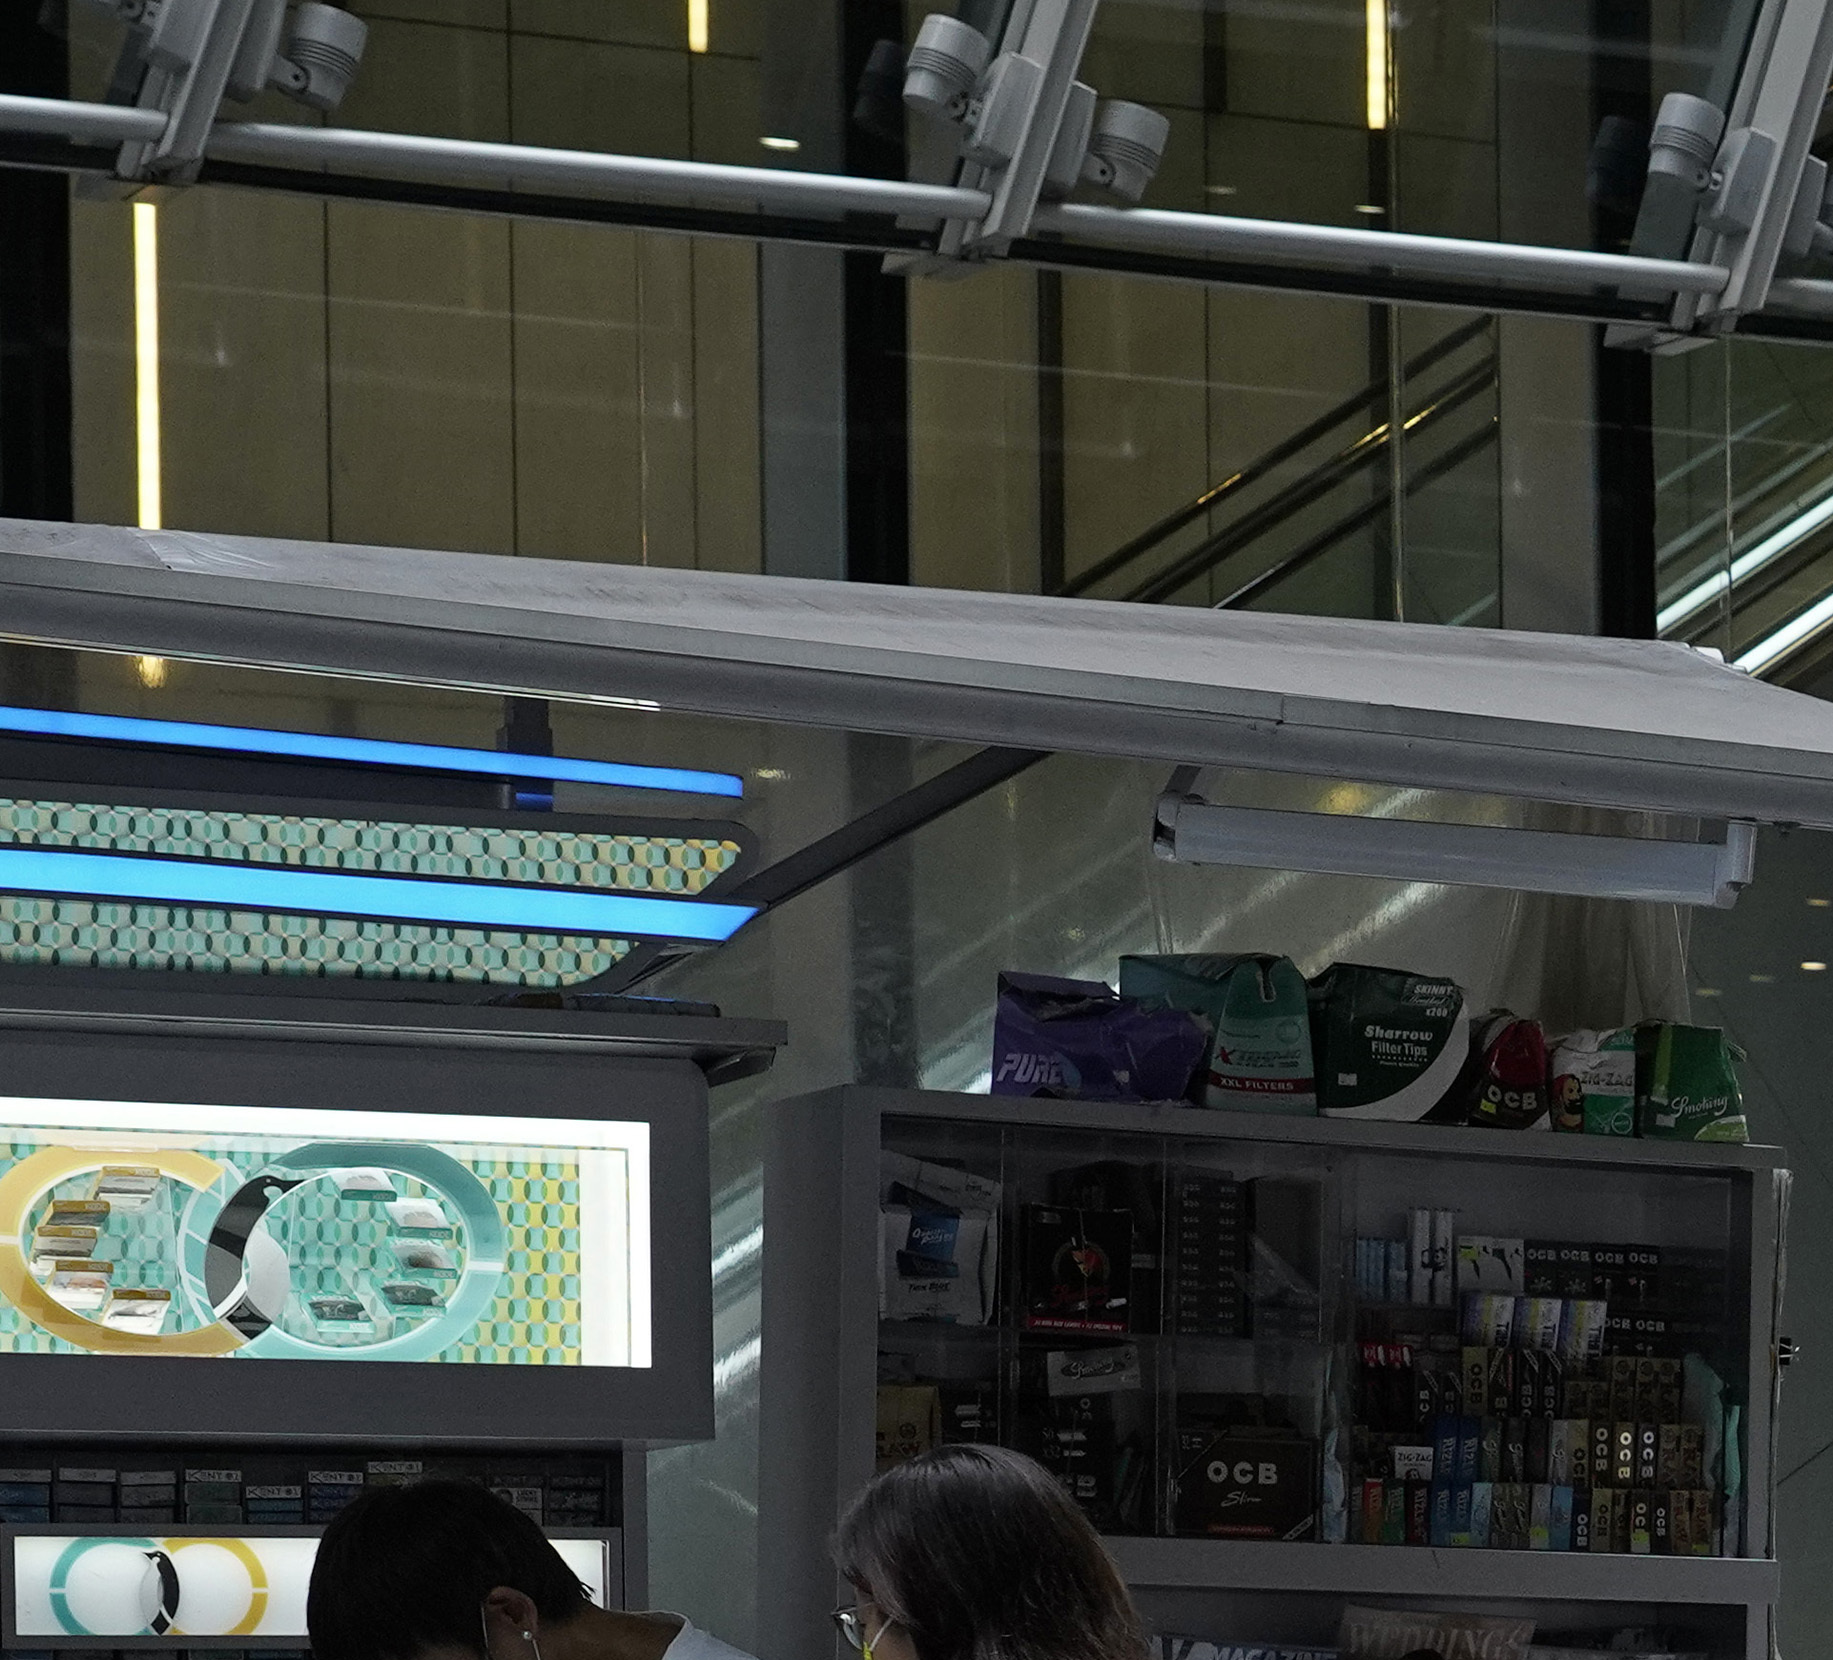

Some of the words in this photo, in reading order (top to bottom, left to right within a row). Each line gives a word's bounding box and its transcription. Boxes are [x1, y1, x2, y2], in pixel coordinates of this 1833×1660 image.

[1364, 1025, 1433, 1041] Sharrow
[1371, 1041, 1399, 1056] Filter
[1399, 1042, 1428, 1058] Tips
[1246, 1079, 1294, 1091] FILTERS
[1487, 1083, 1538, 1112] OCB
[1671, 1094, 1729, 1120] Smoking
[1618, 1431, 1632, 1479] OCB
[1641, 1431, 1655, 1479] OCB
[1207, 1460, 1279, 1486] OCB
